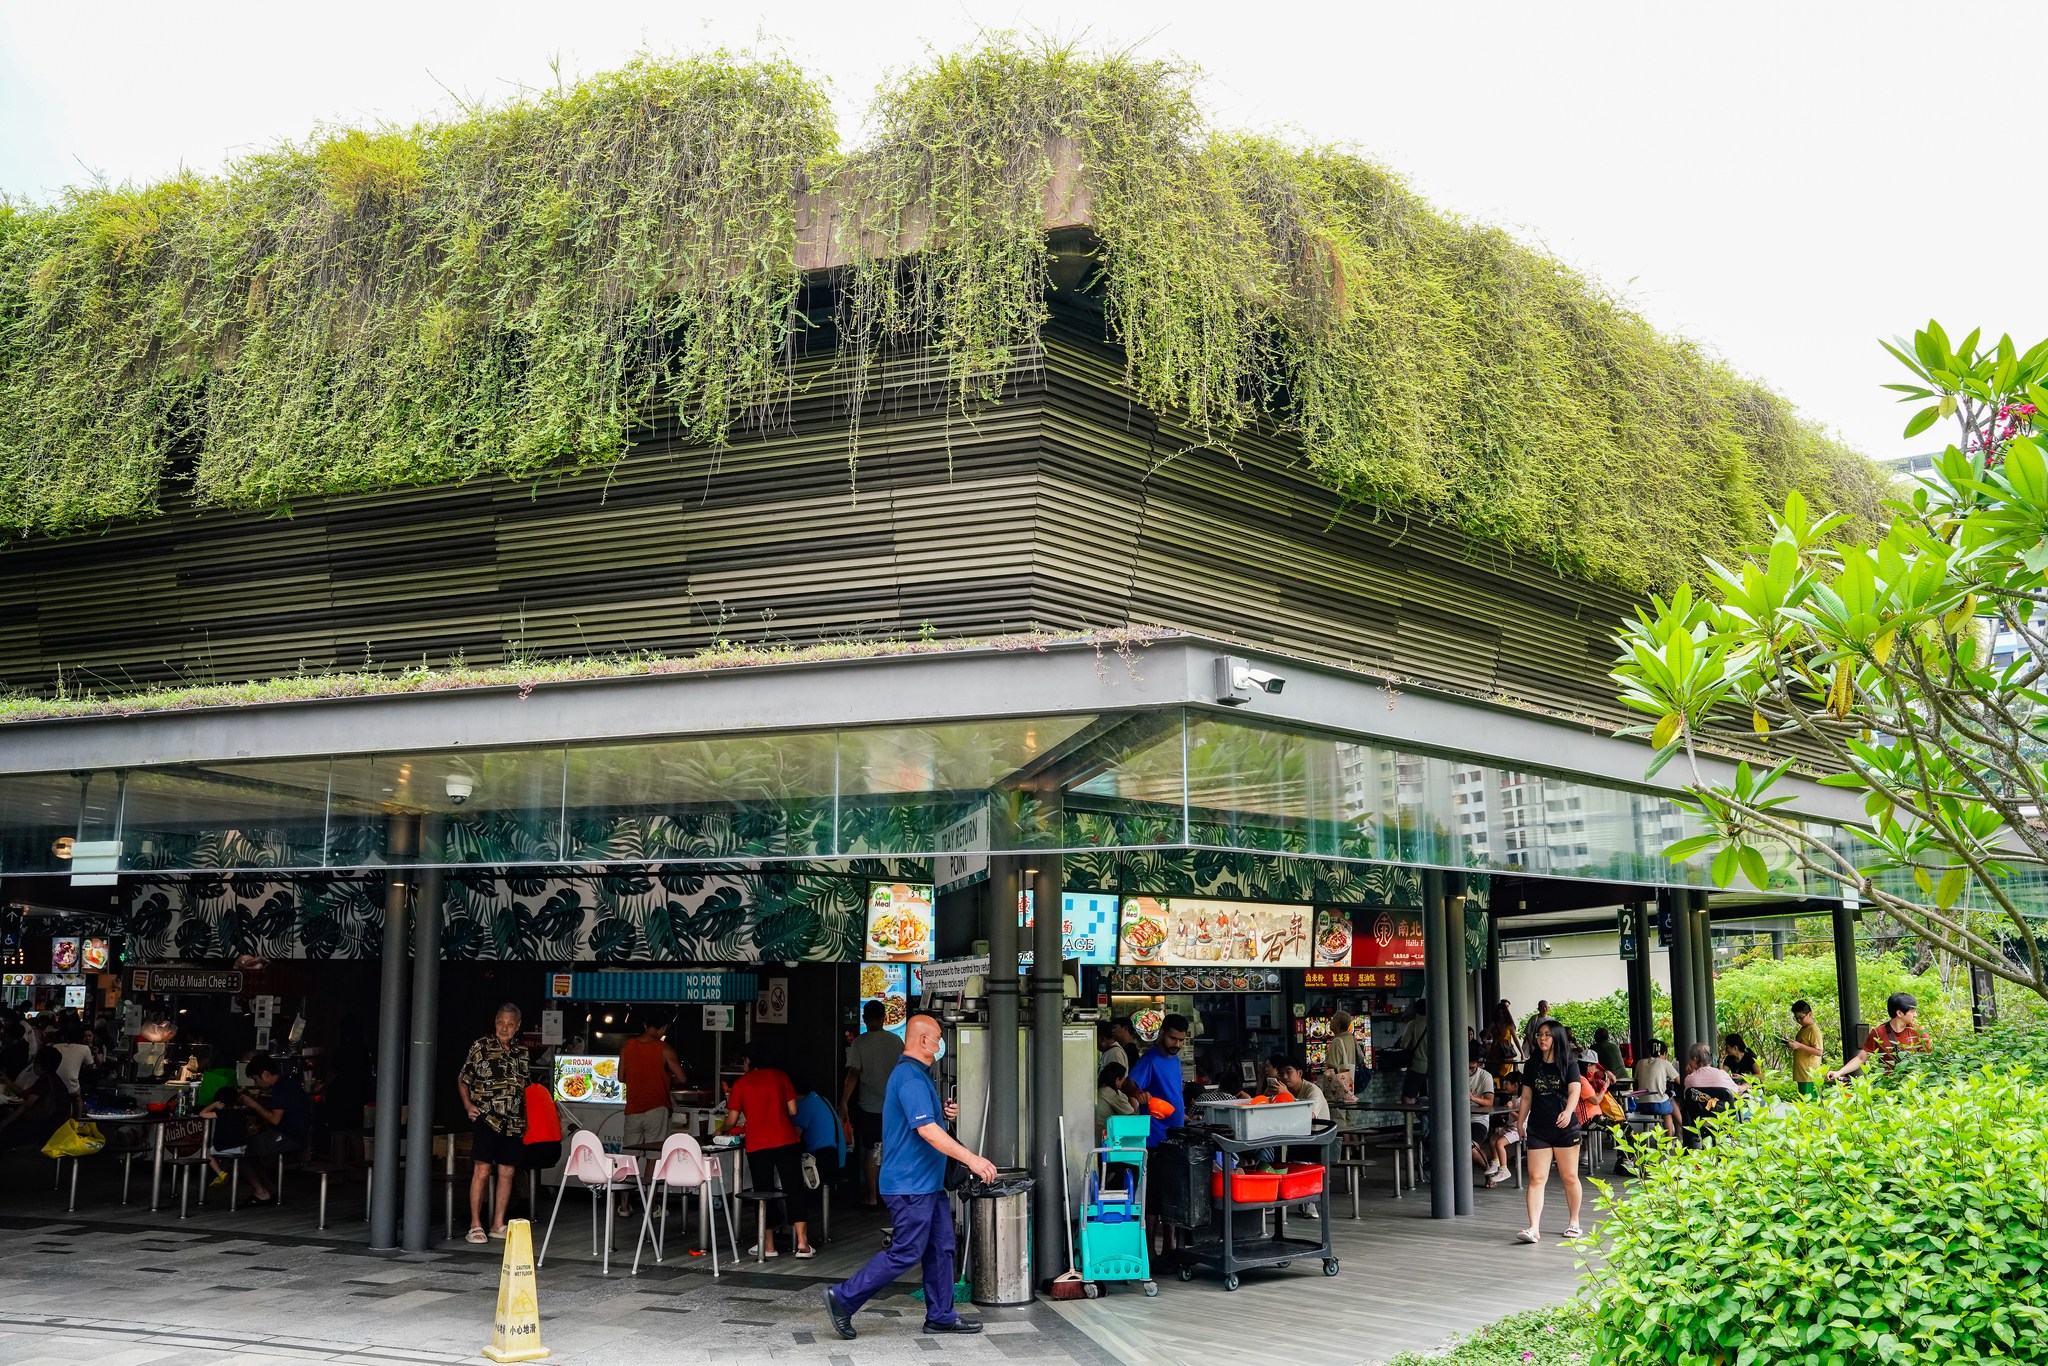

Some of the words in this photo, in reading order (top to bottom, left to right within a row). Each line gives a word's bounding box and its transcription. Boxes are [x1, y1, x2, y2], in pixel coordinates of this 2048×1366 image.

[942, 828, 956, 853] TRAY
[956, 817, 977, 850] RETURN
[950, 849, 968, 877] POINT
[874, 900, 891, 908] Meal
[1623, 914, 1631, 935] 2
[1405, 939, 1419, 947] HaHa
[922, 968, 935, 978] Please
[934, 966, 950, 979] proceed
[961, 964, 972, 974] central
[154, 974, 179, 989] Popiah
[179, 975, 186, 987] &
[186, 975, 207, 988] Muah
[208, 975, 227, 988] Chee
[686, 975, 699, 986] NO
[700, 975, 722, 986] PORK
[687, 988, 699, 1000] NO
[702, 988, 721, 1000] LARD
[186, 1119, 203, 1136] Che
[510, 1324, 536, 1335] 小心地滑
